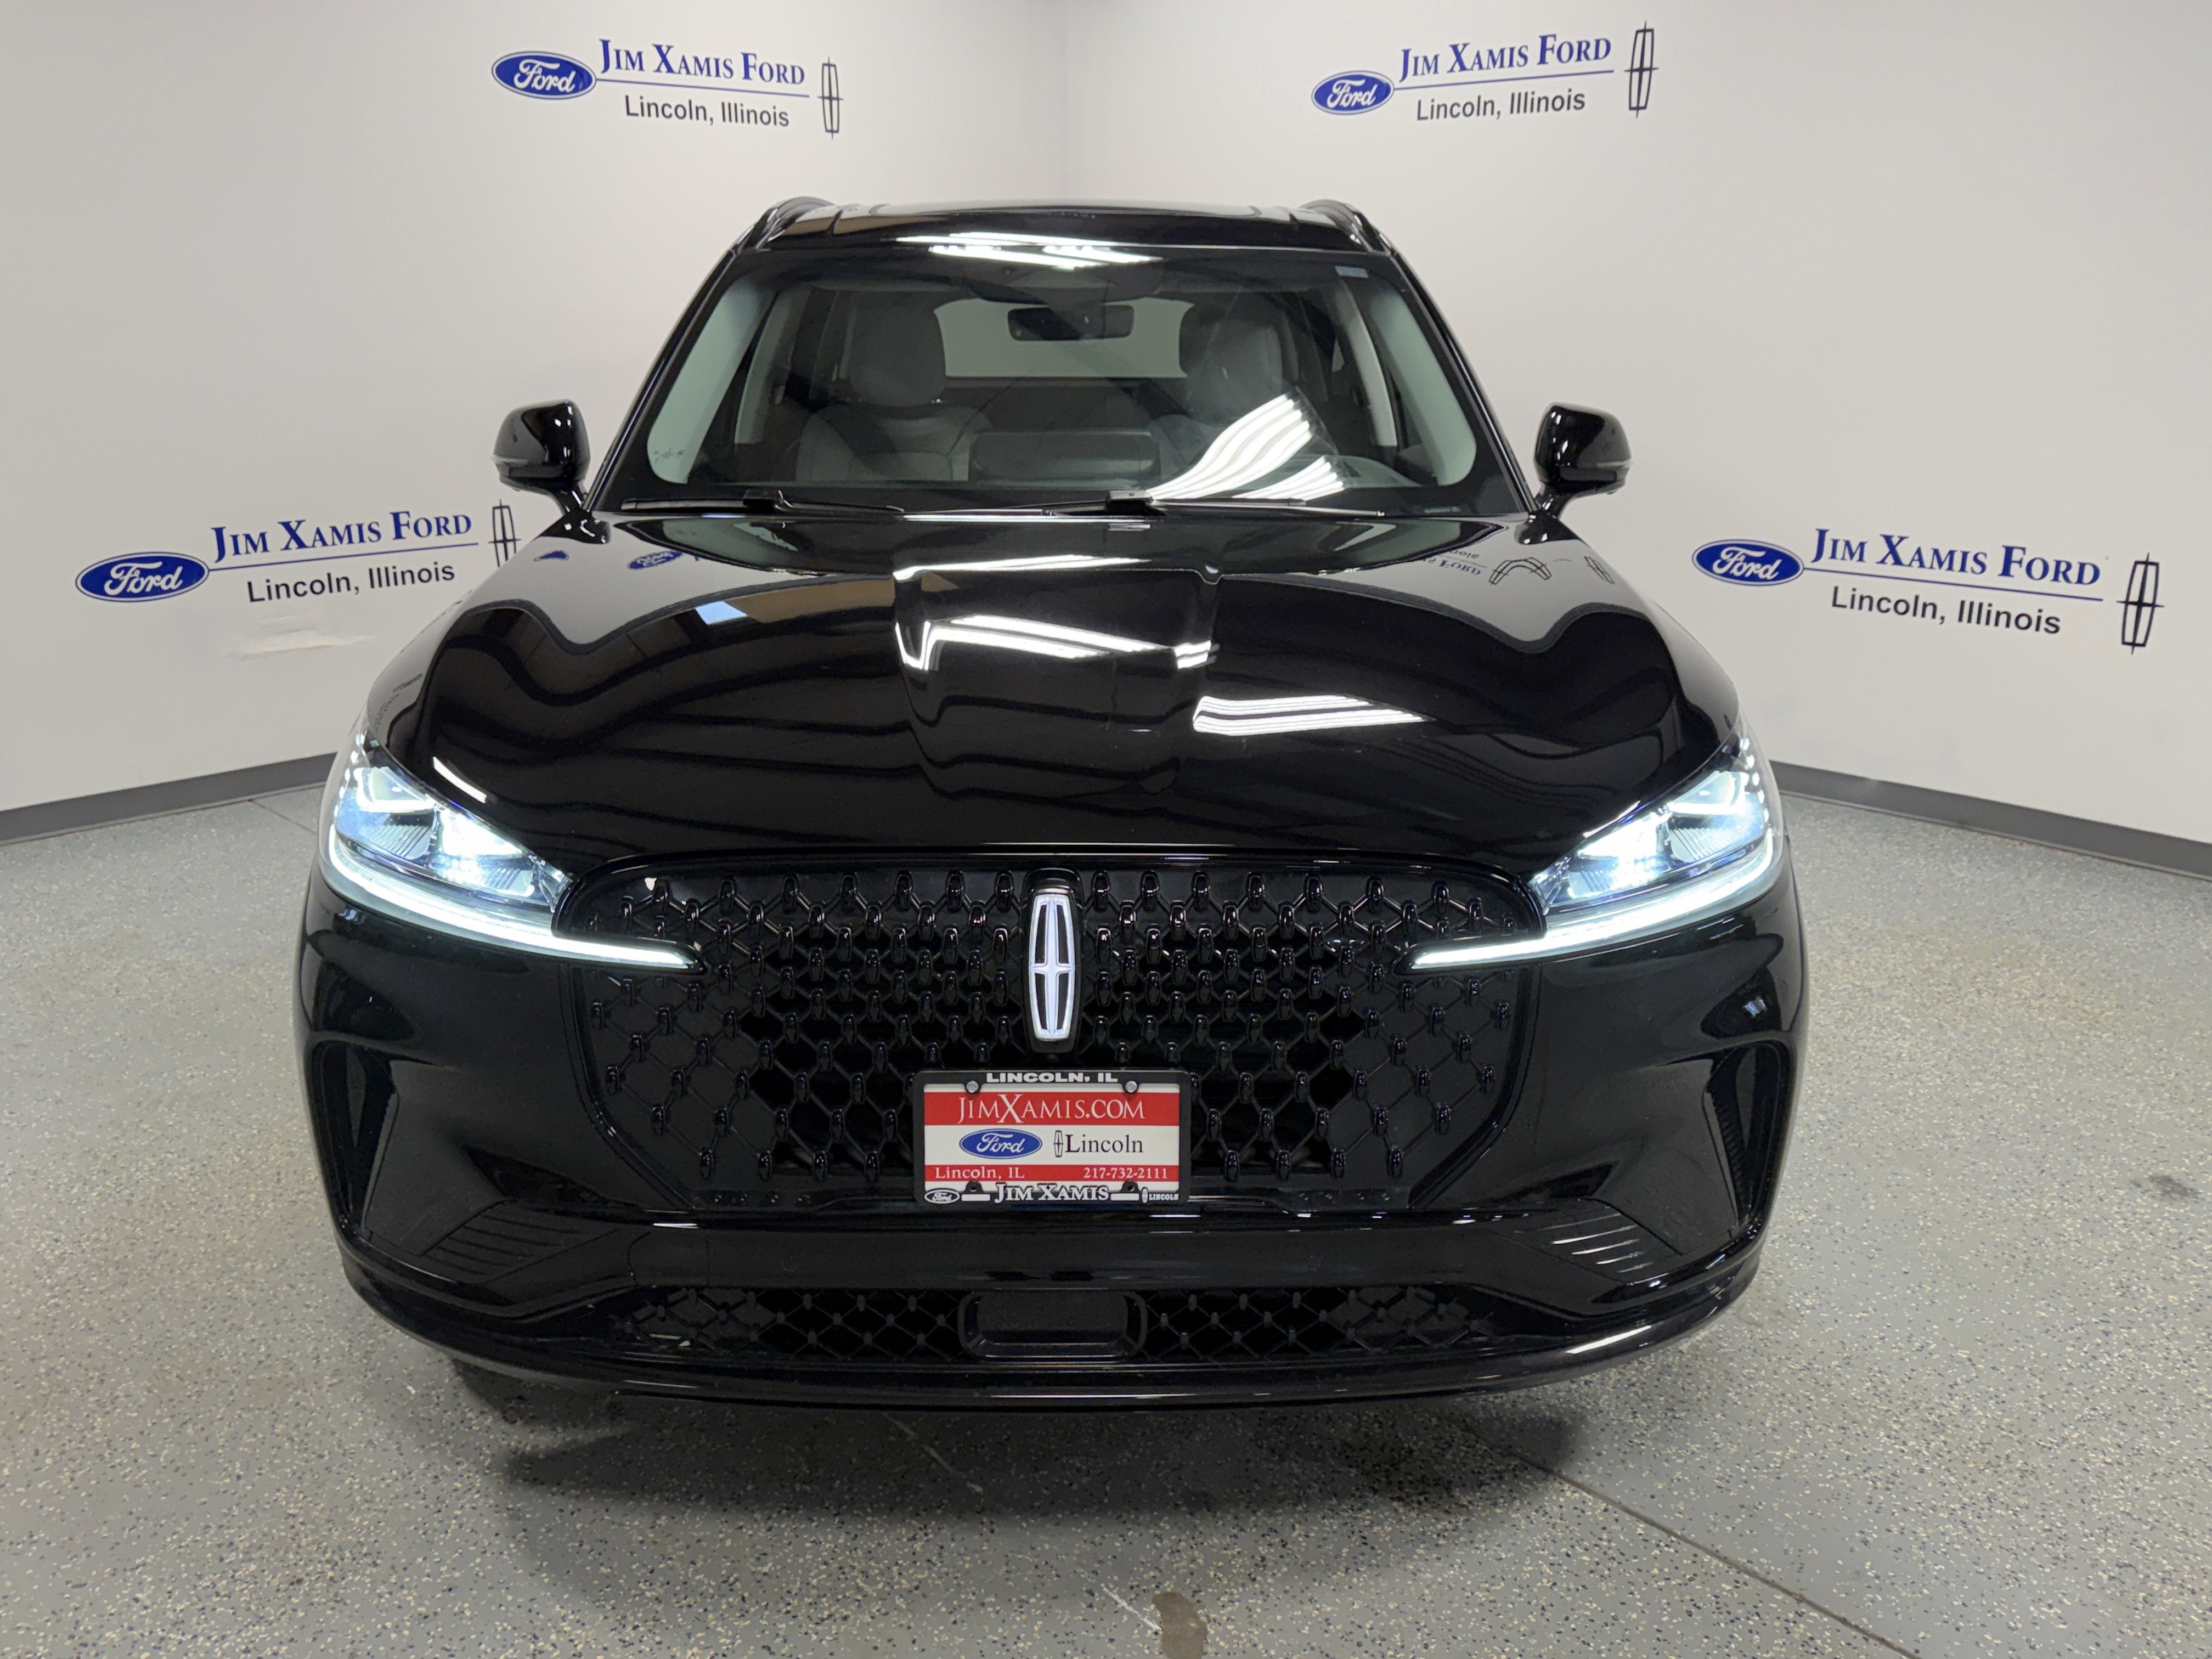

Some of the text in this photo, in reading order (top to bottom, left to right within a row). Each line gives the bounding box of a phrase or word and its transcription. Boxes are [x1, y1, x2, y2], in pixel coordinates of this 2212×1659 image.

[600, 40, 804, 83] JIM XAMIS FORD
[1400, 35, 1611, 82] JIM XAMIS FORD
[513, 58, 575, 93] Ford
[1327, 78, 1377, 108] Ford
[1418, 89, 1585, 120] Lincoln, Illinois
[625, 95, 788, 126] Lincoln, Illinois
[211, 511, 471, 563] JIM XAMIS FORD
[1712, 545, 1782, 580] Ford
[1811, 529, 2100, 585] JIM XAMIS FORD
[103, 561, 183, 596] Ford
[247, 562, 455, 602] Lincoln, Illinois
[1832, 586, 2060, 634] Lincoln, Illinois
[987, 1073, 1118, 1082] LINCOLN, IL
[958, 1094, 1144, 1124] JIMXAMIS.COM
[976, 1132, 1024, 1153] Ford
[1065, 1135, 1143, 1153] Lincoln
[936, 1166, 1024, 1180] Lincoln, IL
[1084, 1167, 1167, 1178] 217-732-2111
[994, 1183, 1109, 1204] JIM XAMIS
